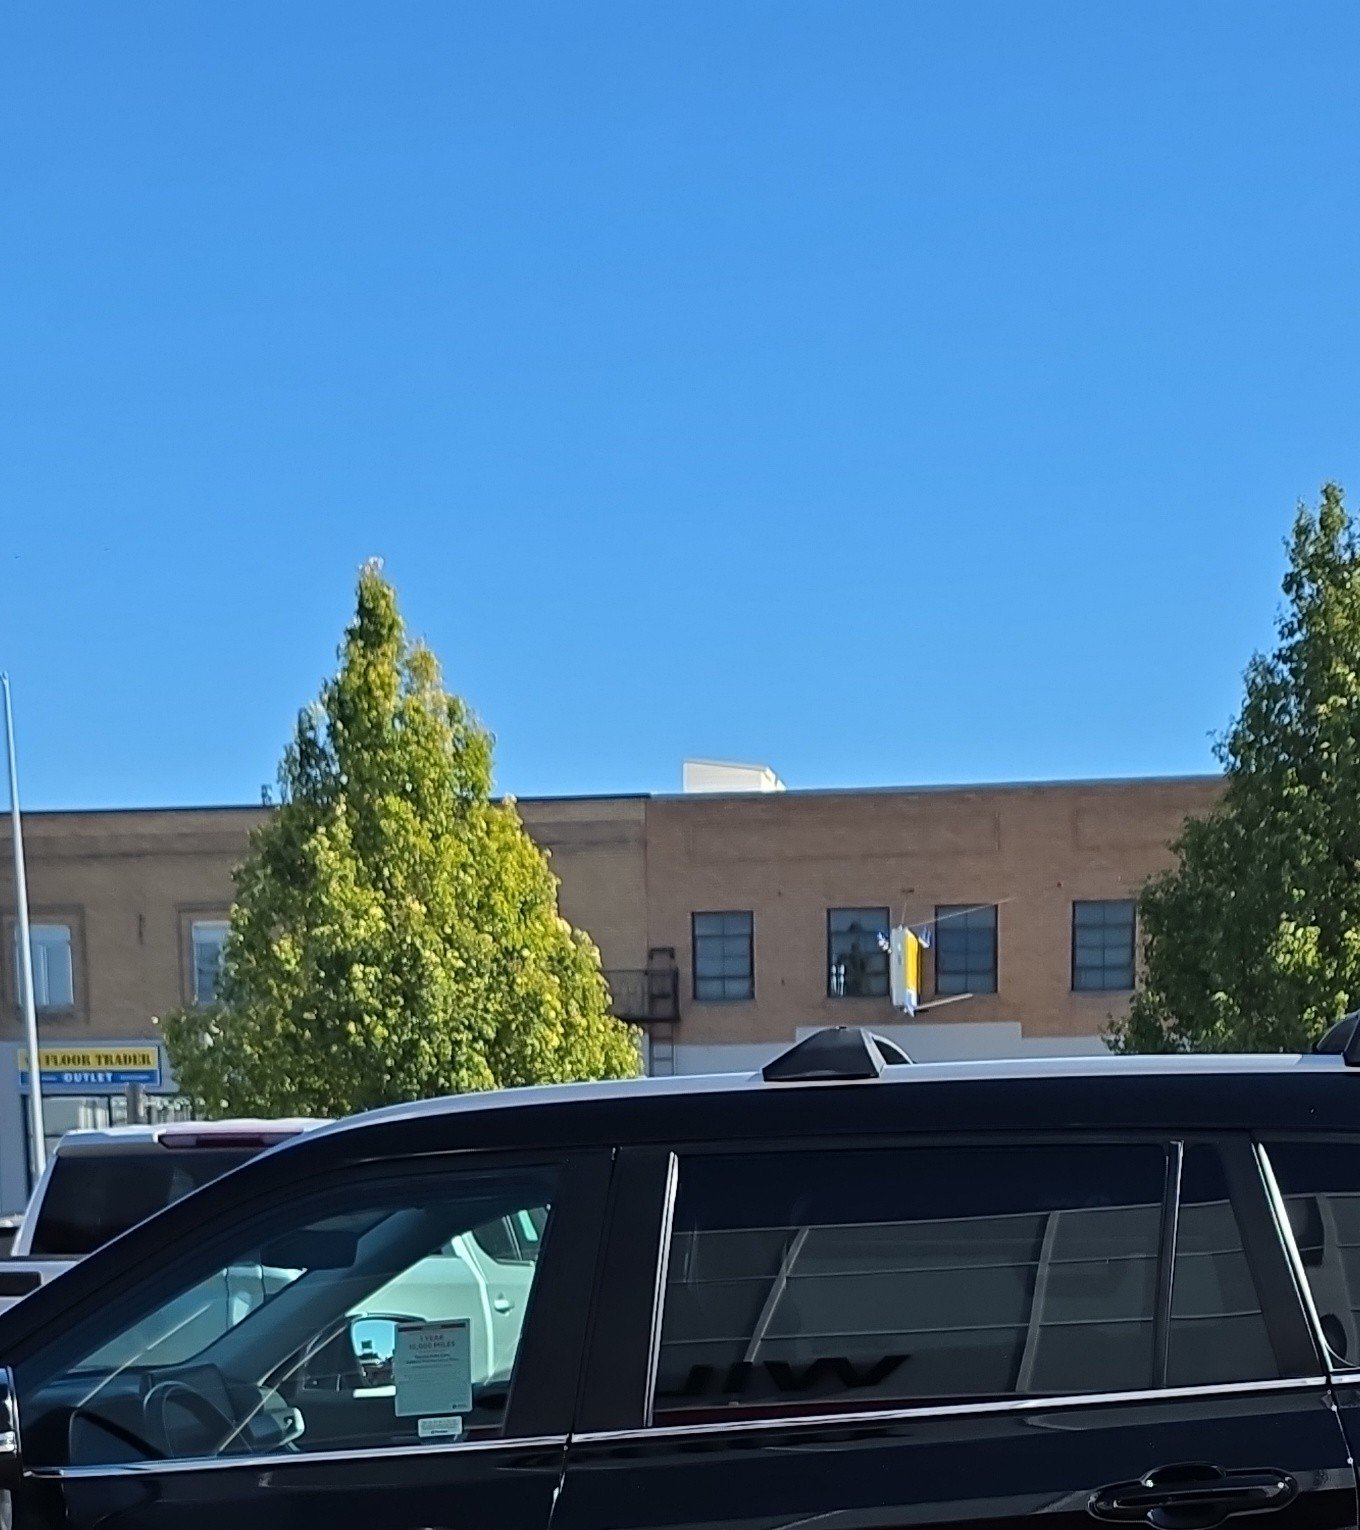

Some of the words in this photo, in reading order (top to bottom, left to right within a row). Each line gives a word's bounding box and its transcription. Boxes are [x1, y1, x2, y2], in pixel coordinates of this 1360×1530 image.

[44, 1053, 91, 1067] FLOOR
[95, 1052, 152, 1066] TRADER
[63, 1072, 113, 1083] OUTLET
